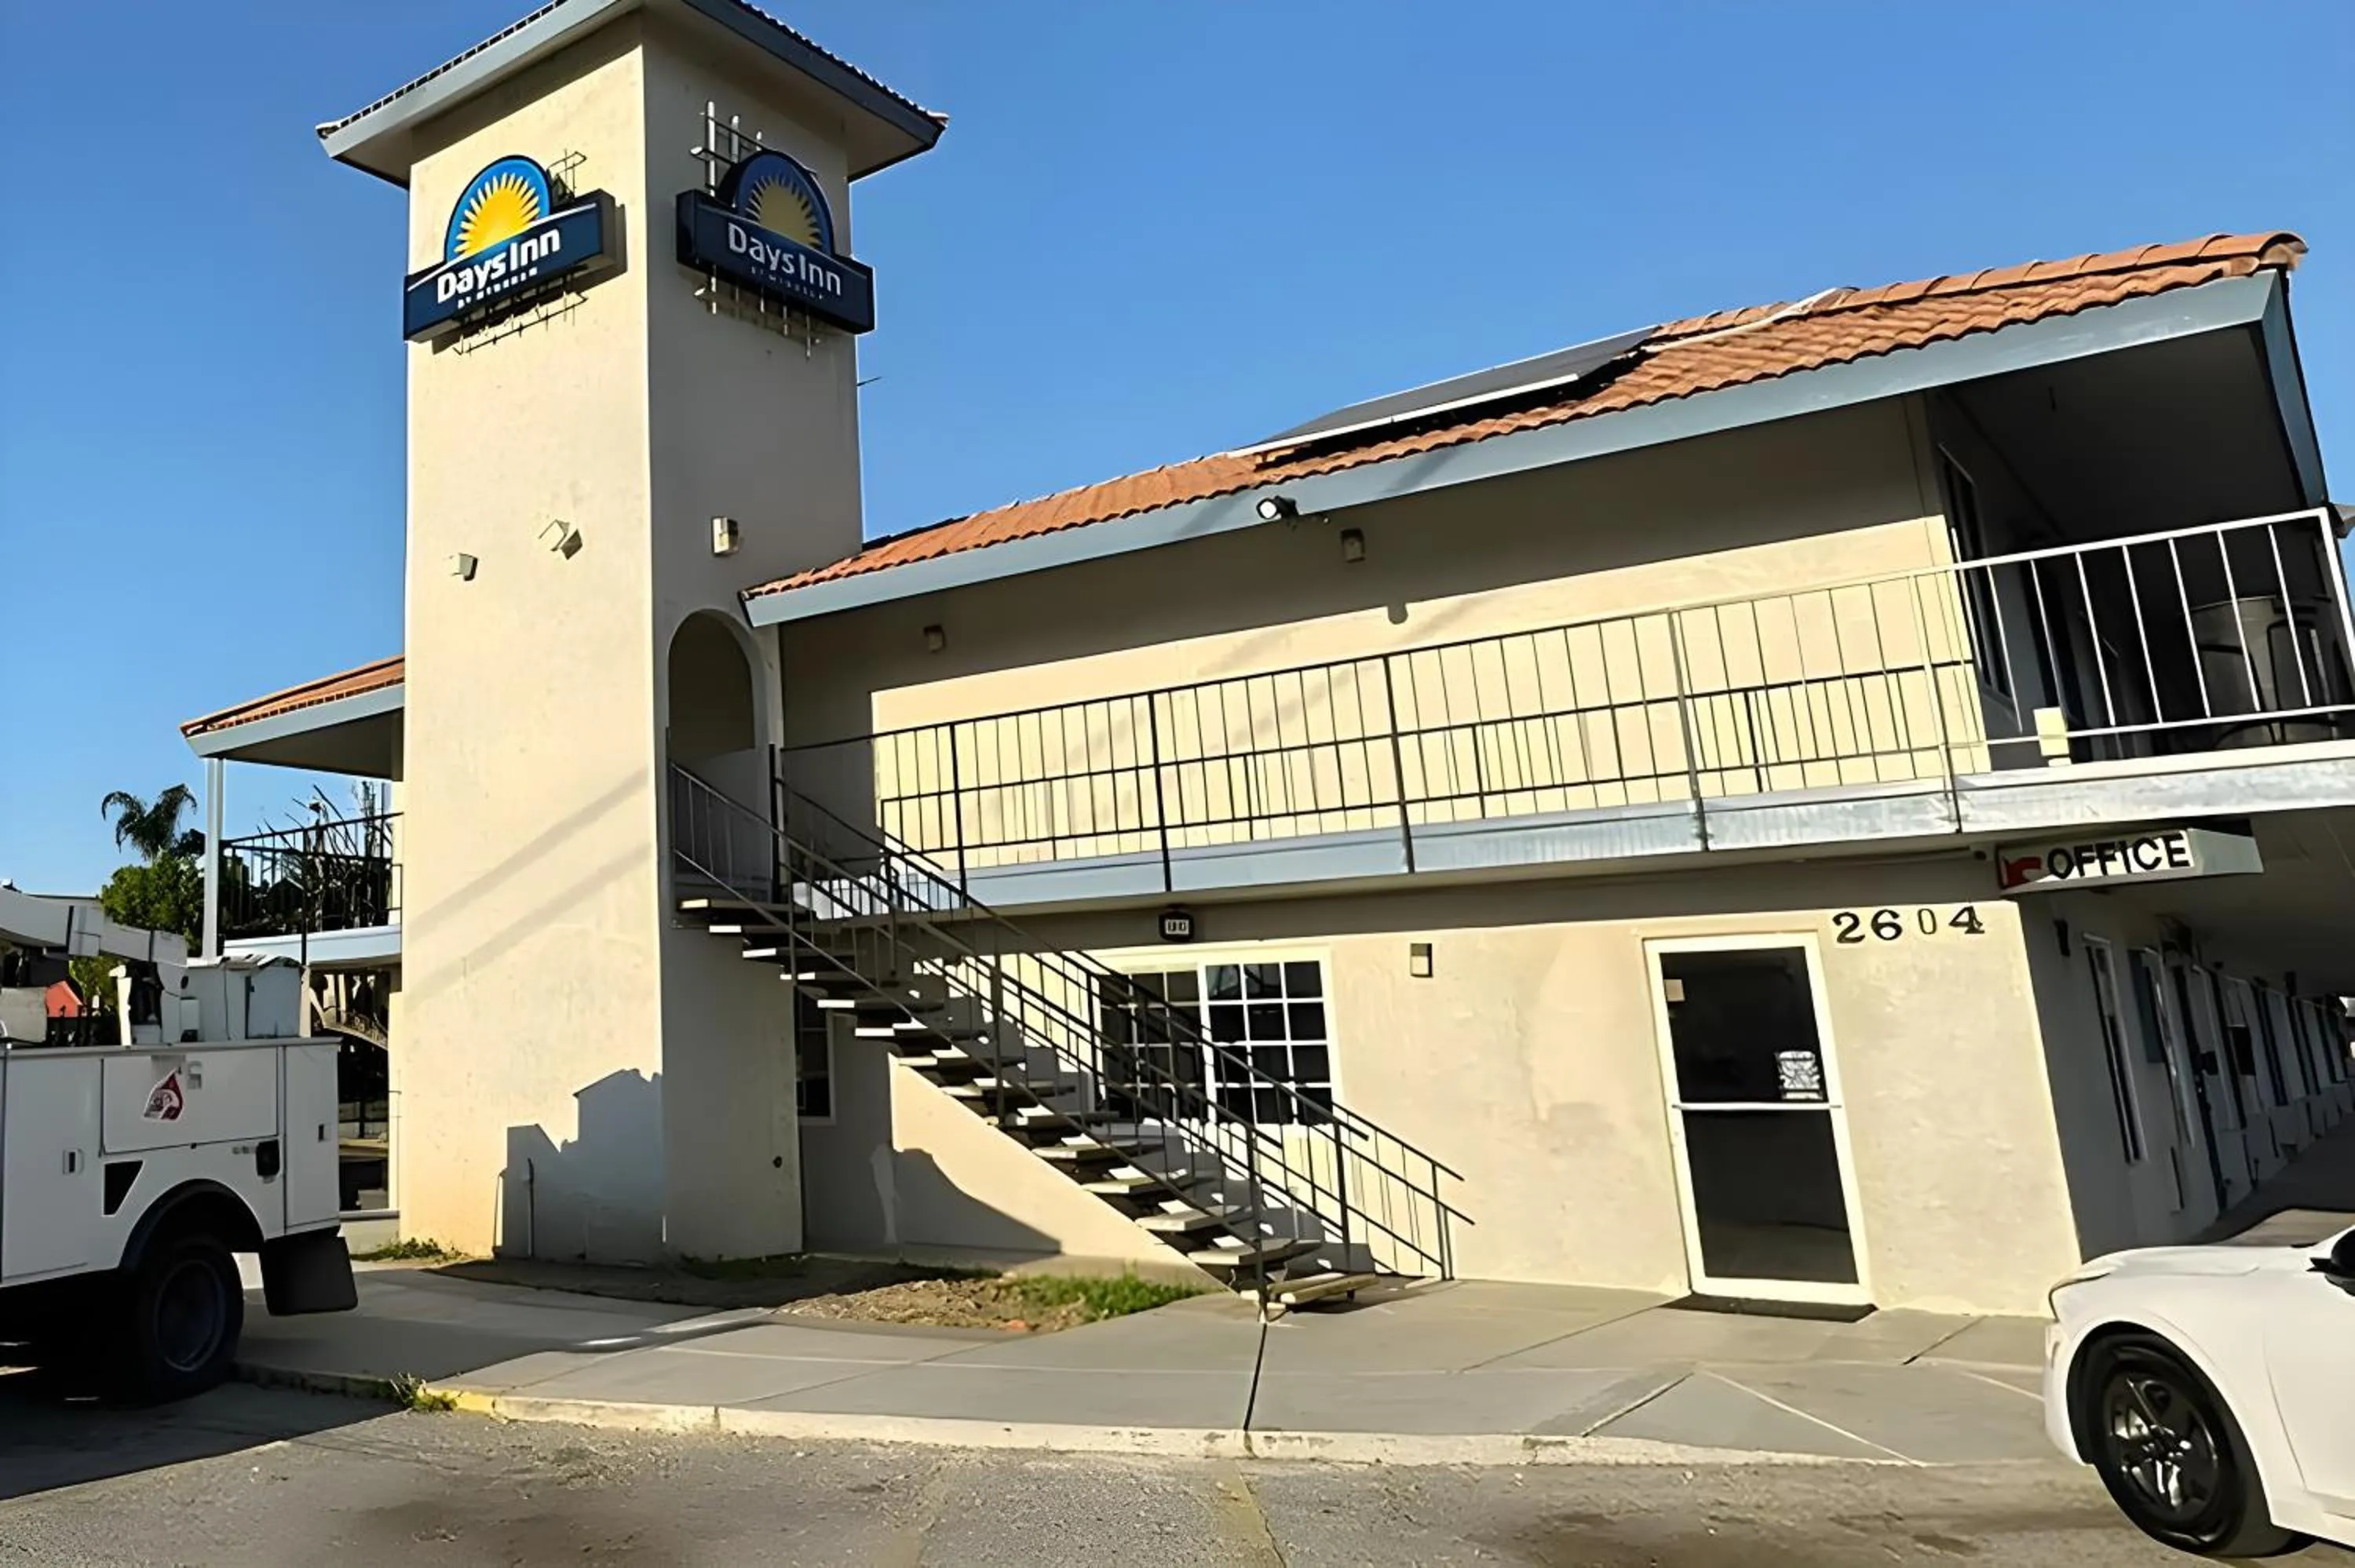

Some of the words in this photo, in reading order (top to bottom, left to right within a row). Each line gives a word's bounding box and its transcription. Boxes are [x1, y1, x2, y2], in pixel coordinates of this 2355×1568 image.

[437, 251, 507, 304] Days
[510, 228, 560, 272] Inn
[728, 222, 794, 274] Days
[798, 253, 842, 297] Inn
[2046, 833, 2191, 880] OFFICE
[1832, 906, 1985, 944] 2604
